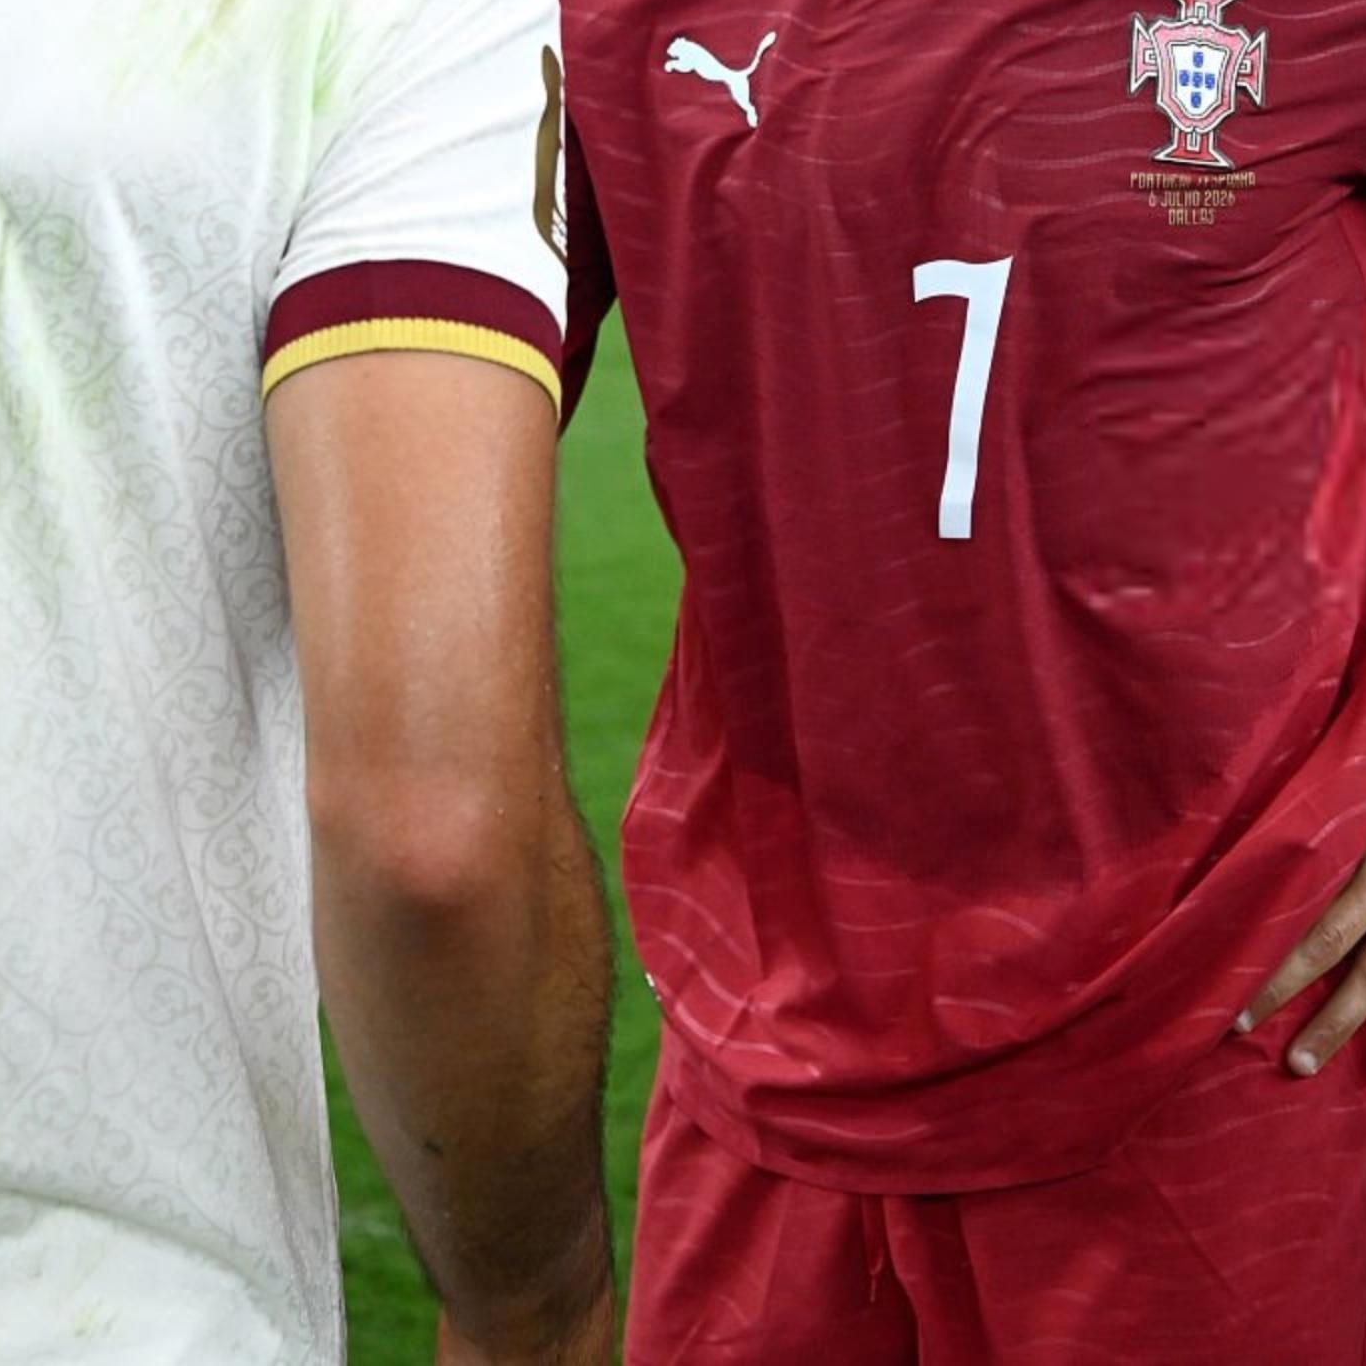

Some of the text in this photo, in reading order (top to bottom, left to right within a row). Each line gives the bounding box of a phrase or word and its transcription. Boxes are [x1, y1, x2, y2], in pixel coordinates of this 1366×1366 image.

[1148, 190, 1236, 207] 6 JULHO 2026
[1168, 207, 1216, 226] DALLAS
[912, 255, 1014, 539] 7
